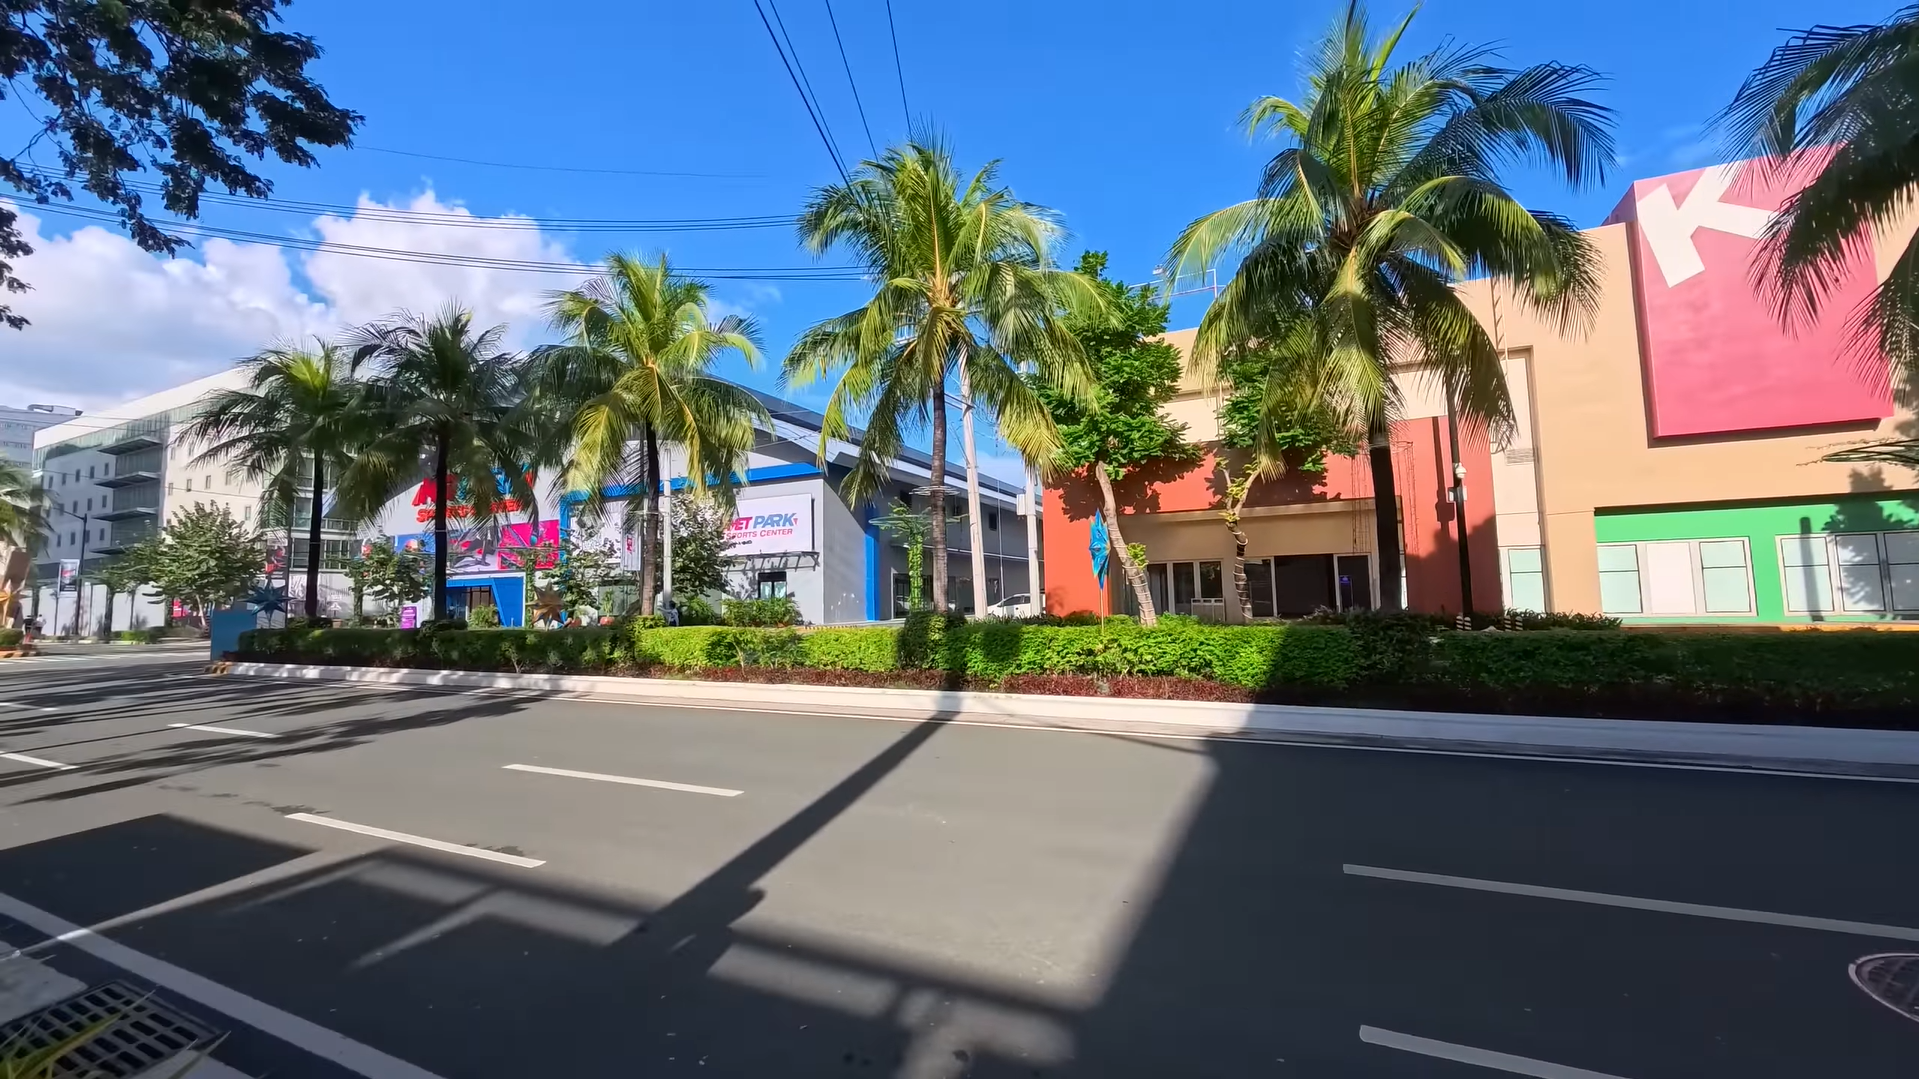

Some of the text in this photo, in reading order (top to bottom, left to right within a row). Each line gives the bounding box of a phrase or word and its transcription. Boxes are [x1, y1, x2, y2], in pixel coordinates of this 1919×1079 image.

[1636, 163, 1782, 288] K
[753, 513, 796, 528] PARK
[760, 529, 793, 537] CENTER
